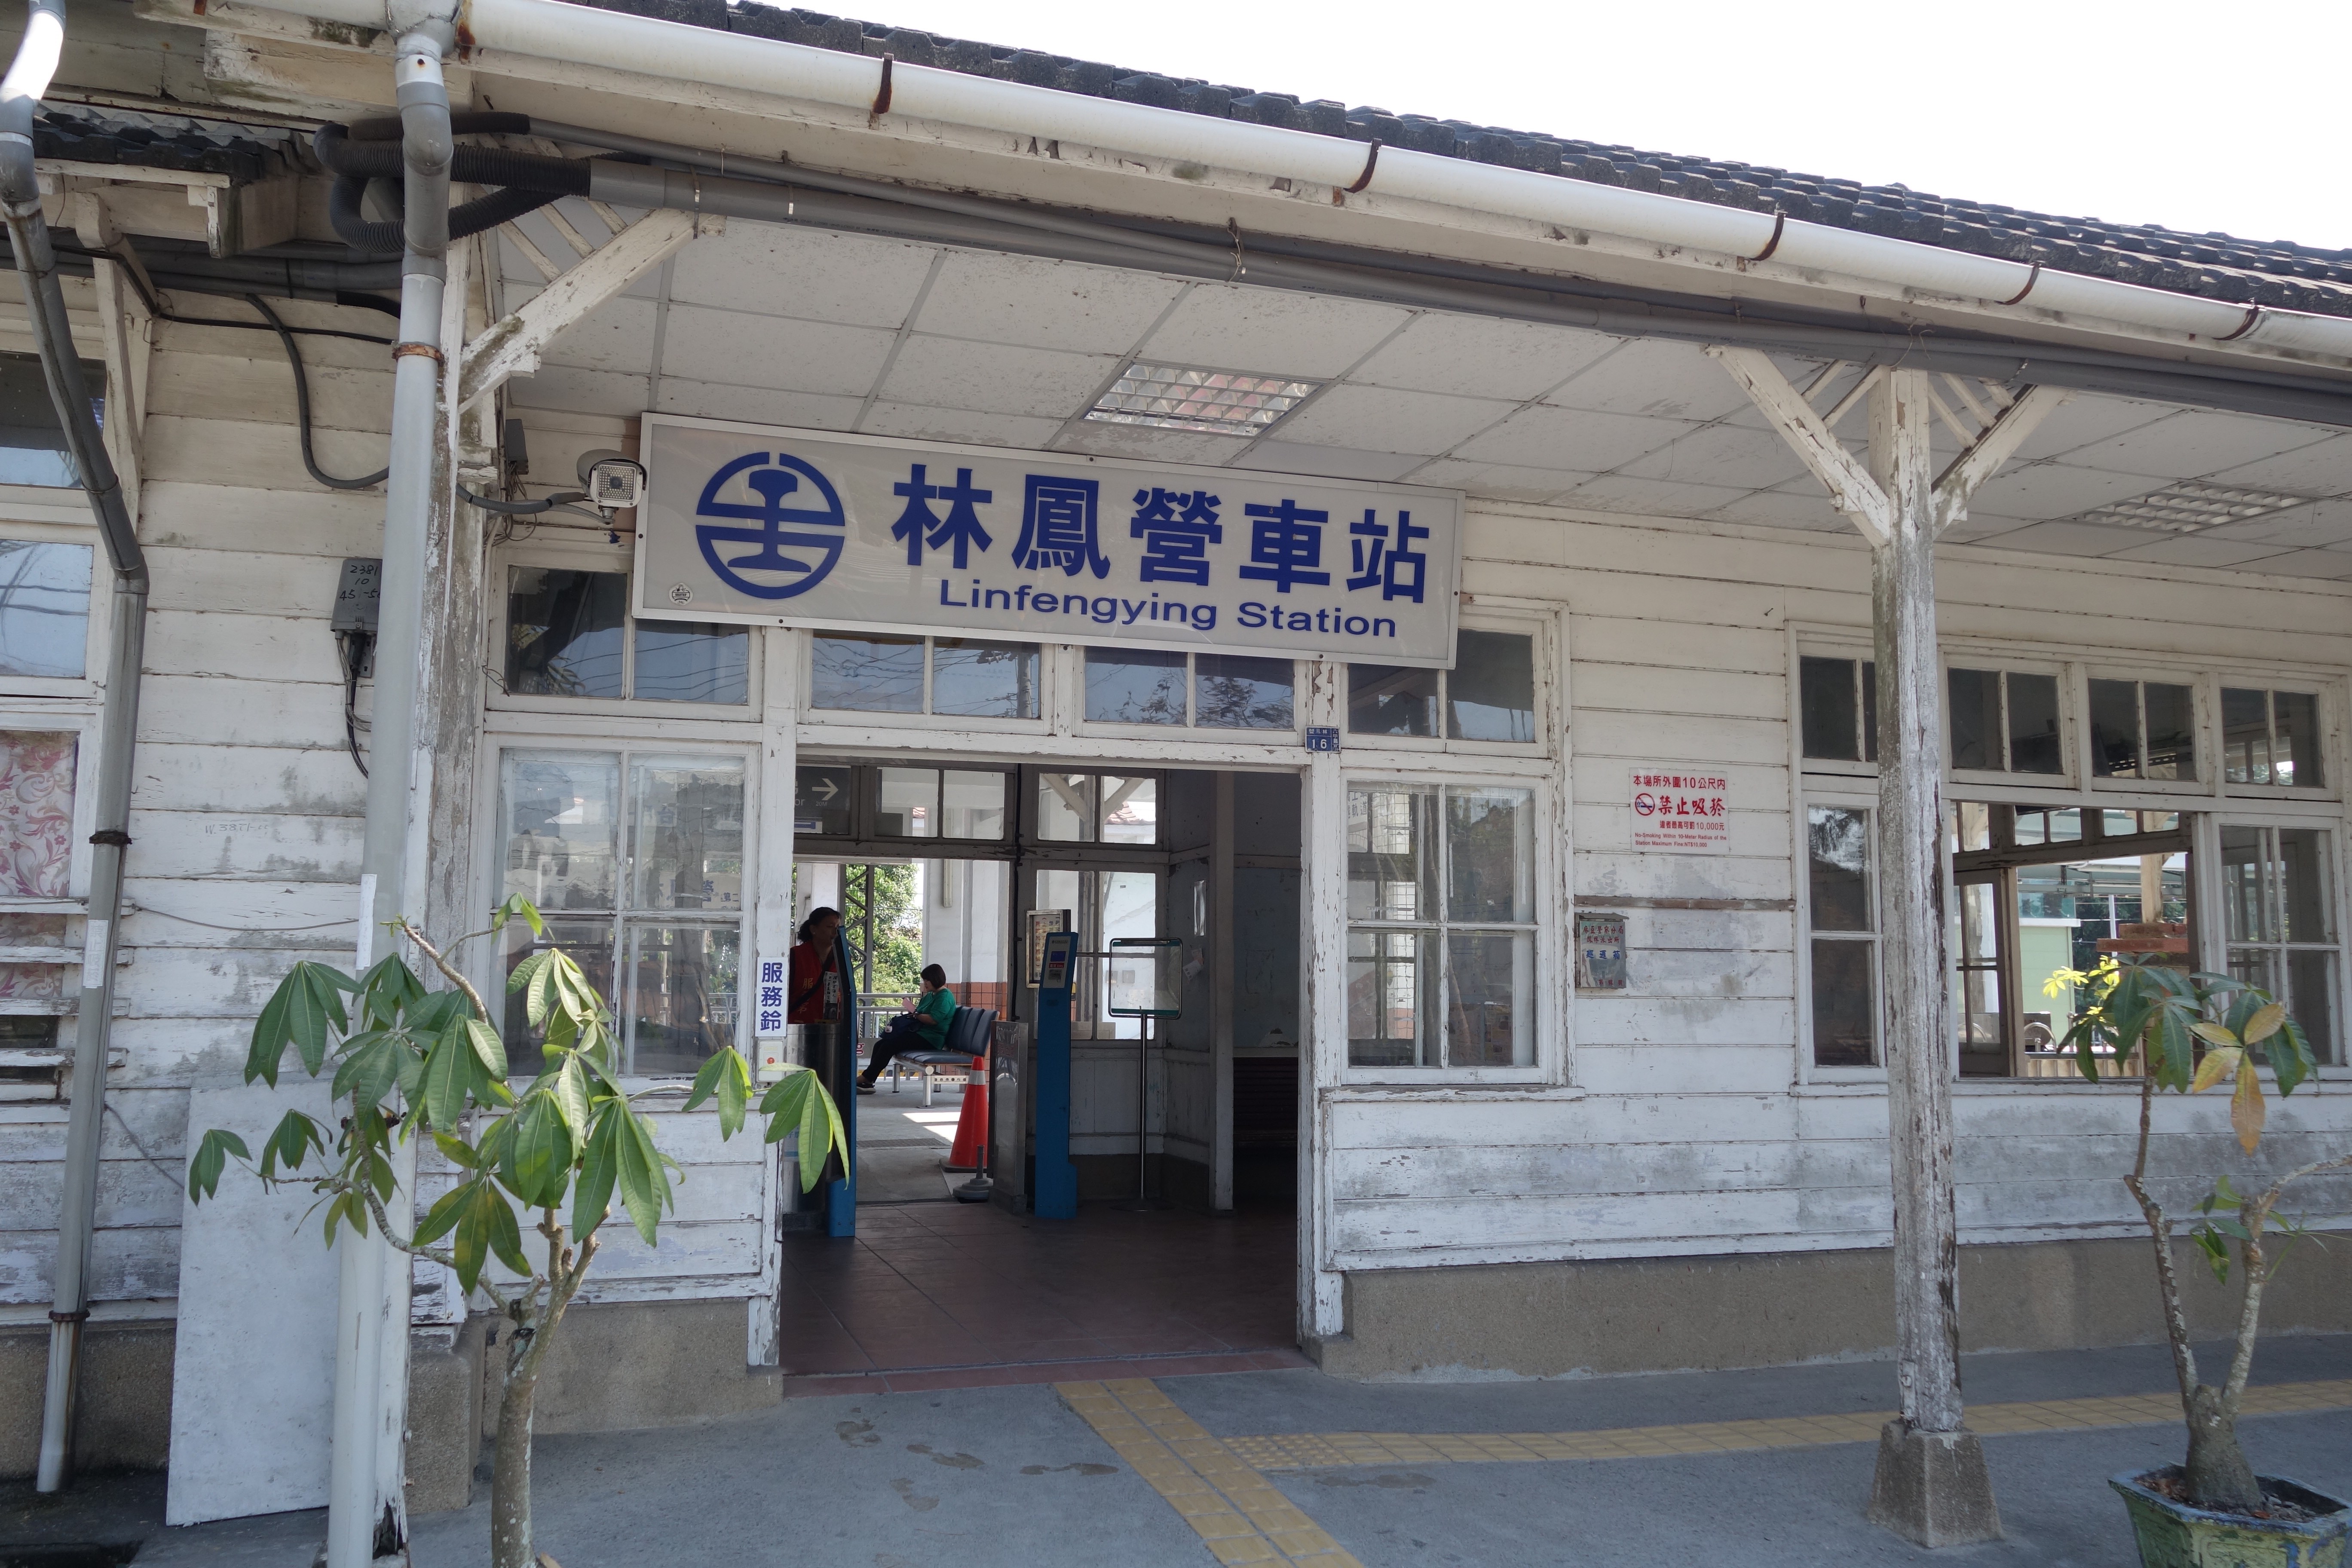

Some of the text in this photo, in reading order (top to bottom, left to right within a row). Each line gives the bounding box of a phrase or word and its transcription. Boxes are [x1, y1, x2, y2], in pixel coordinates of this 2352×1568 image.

[892, 465, 1428, 603] 林鳳營車站
[350, 565, 378, 576] 2381
[941, 580, 1395, 636] Linfengying Station
[1312, 739, 1327, 749] 16
[1658, 795, 1725, 817] 禁止吸菸
[760, 962, 783, 1031] 服務鈴
